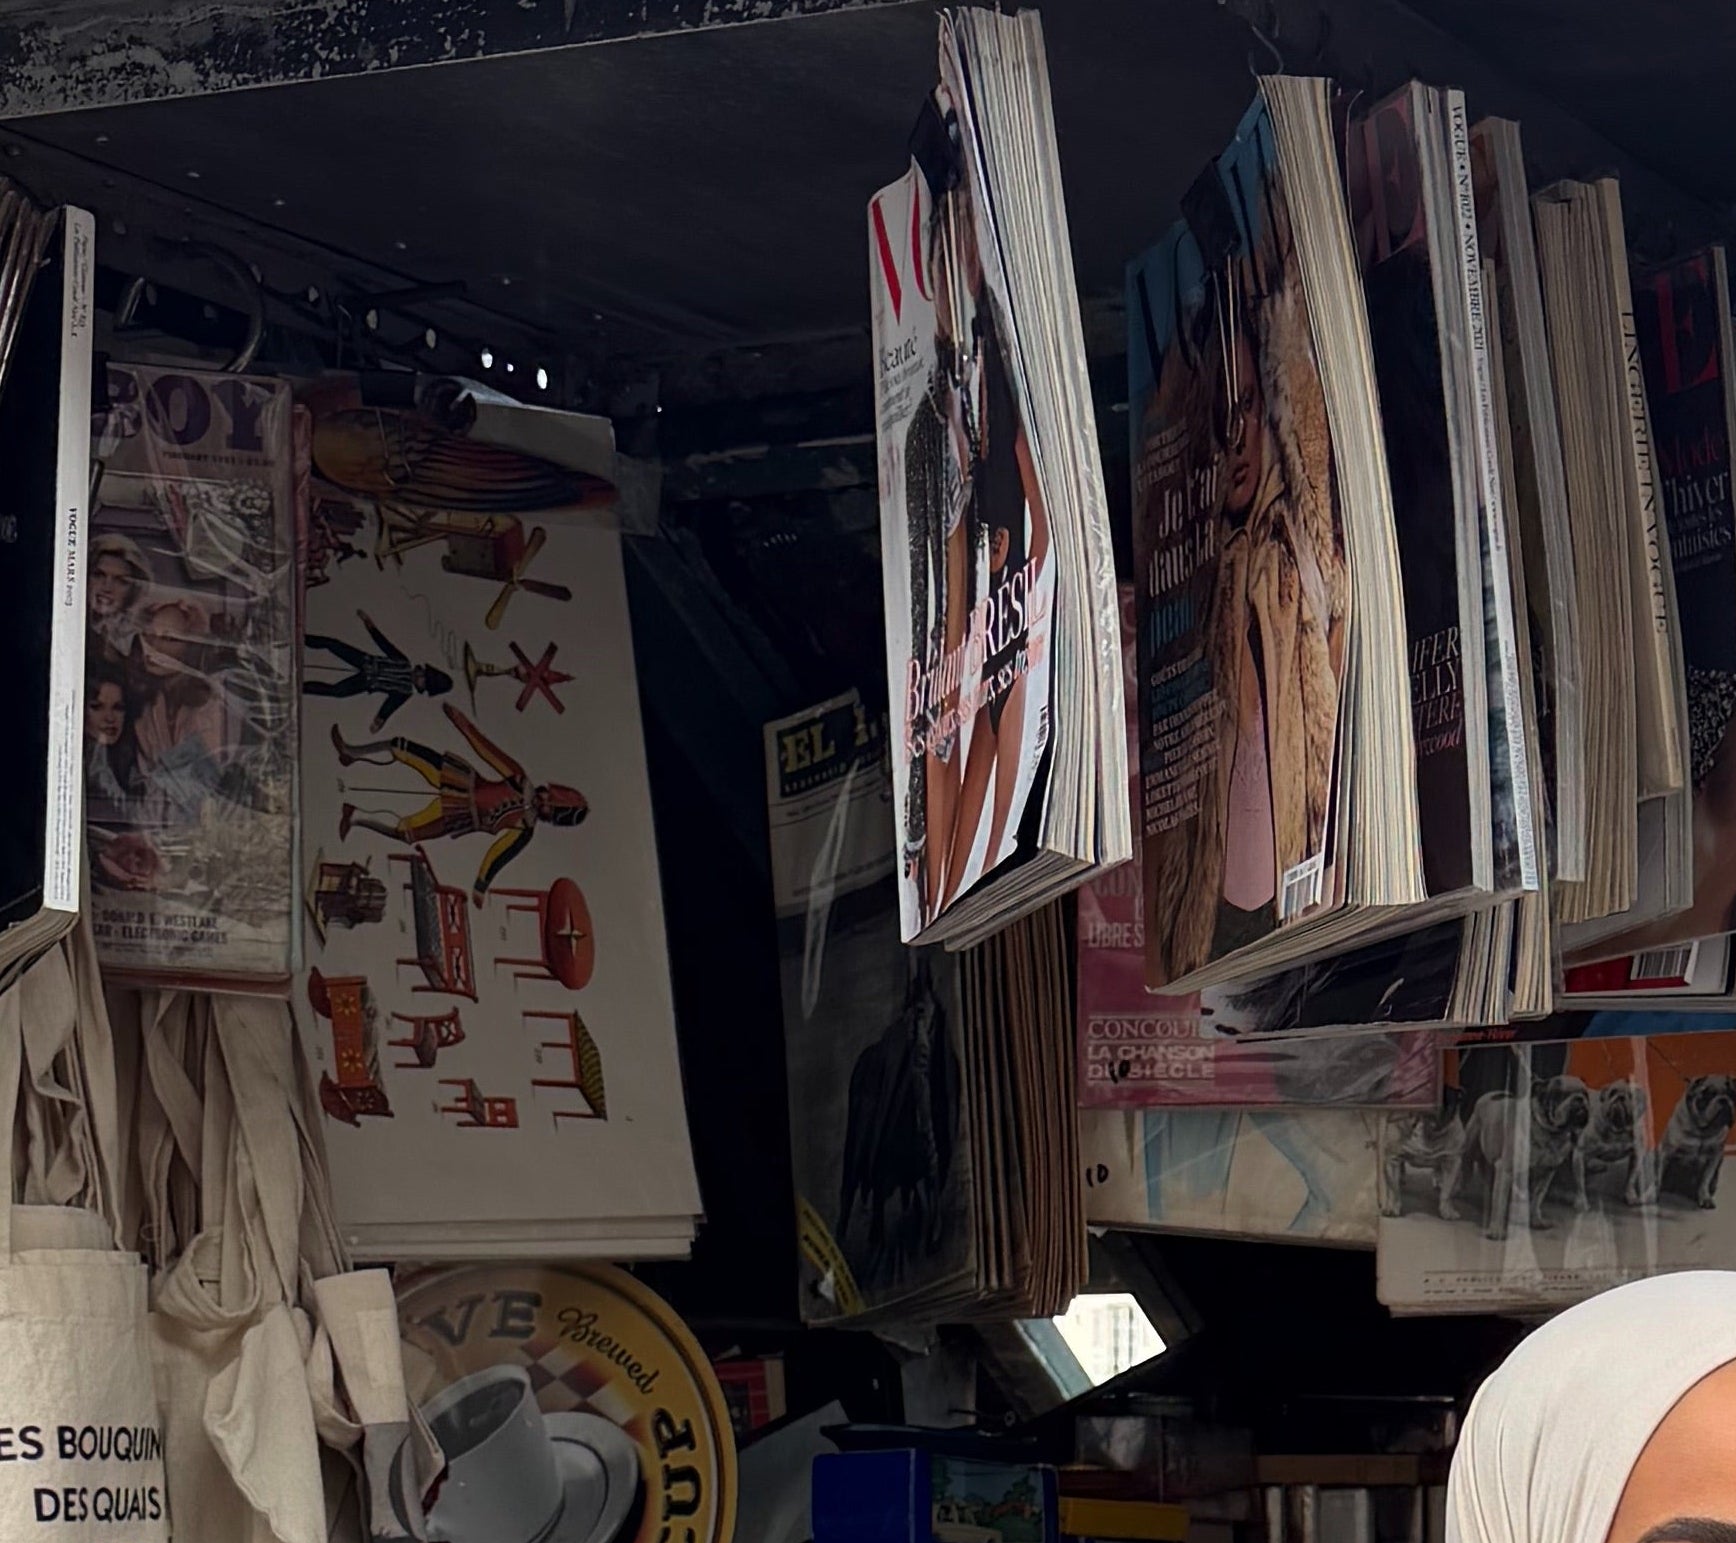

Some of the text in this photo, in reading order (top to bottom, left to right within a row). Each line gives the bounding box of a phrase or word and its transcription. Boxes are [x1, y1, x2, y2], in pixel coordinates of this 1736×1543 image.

[1464, 232, 1484, 324] NOVEMBRE
[1620, 311, 1650, 477] LINGERIE
[1645, 519, 1669, 635] VOGUE
[1086, 1162, 1108, 1188] 10
[556, 1305, 664, 1396] Brewed
[34, 1485, 162, 1522] DES QUAIS
